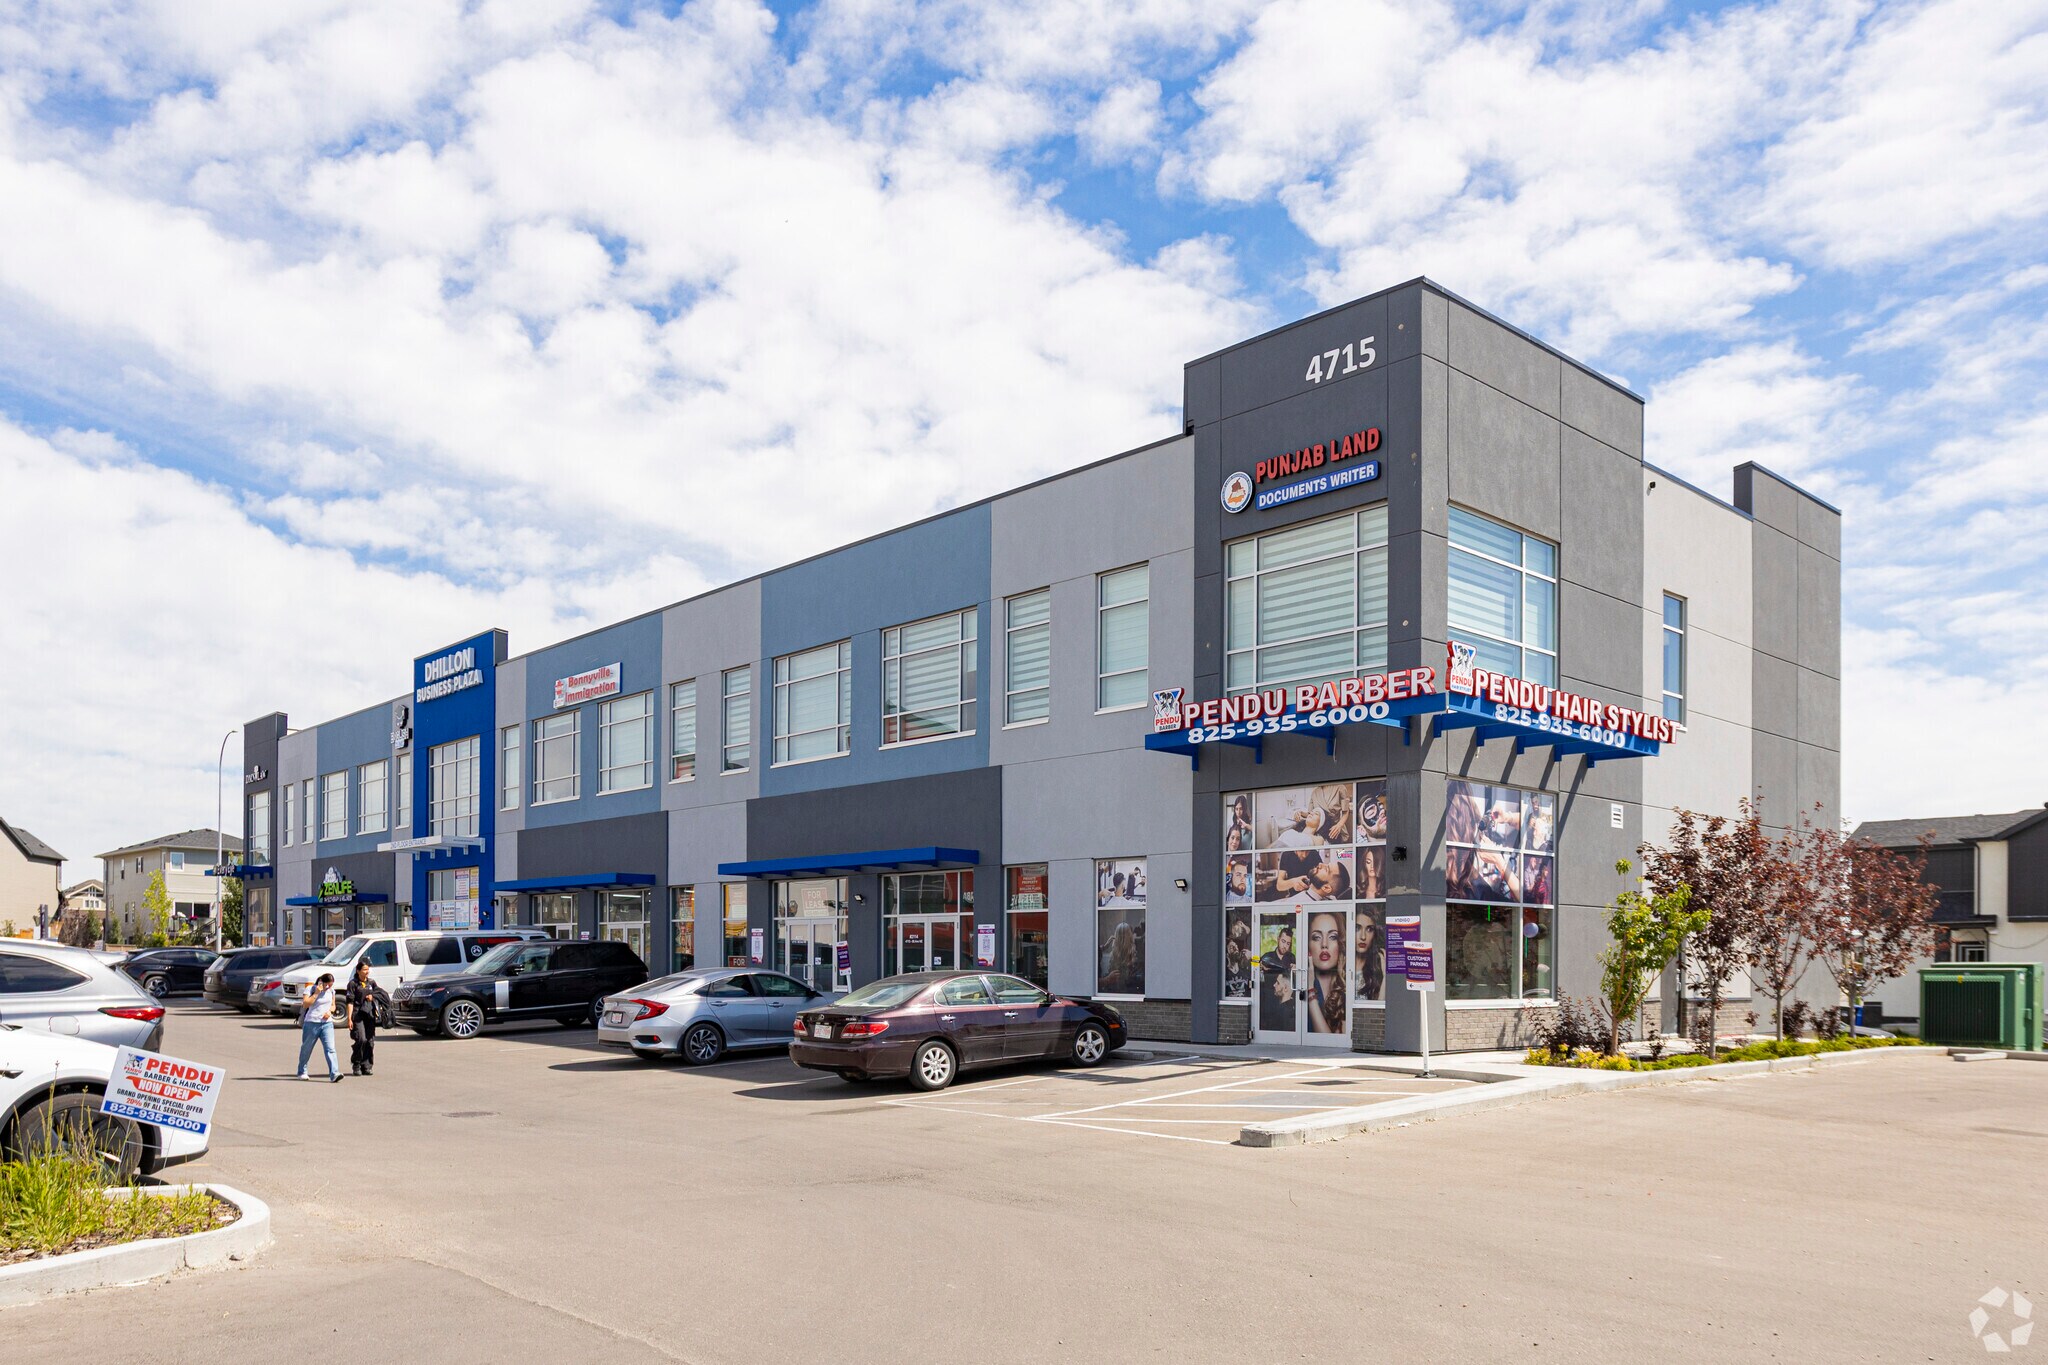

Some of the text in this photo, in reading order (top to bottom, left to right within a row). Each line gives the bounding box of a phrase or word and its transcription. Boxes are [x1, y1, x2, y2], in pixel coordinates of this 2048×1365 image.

[1305, 335, 1376, 384] 4715
[1255, 427, 1381, 484] PUNJAB LAND
[1258, 477, 1328, 508] DOCUMENTS
[1330, 464, 1375, 488] WRITER
[424, 647, 475, 683] DHILLON
[568, 667, 611, 688] Bonnyville
[416, 668, 484, 703] BUSINESS PLAZA
[564, 681, 616, 703] Immigration
[1452, 675, 1472, 687] PENDU
[1184, 666, 1436, 729] PENDU BARBER
[1473, 668, 1681, 744] PENDU HAIR STYLIST
[1155, 715, 1180, 726] PENDU
[1159, 723, 1177, 731] BARBER
[1188, 702, 1390, 744] 825-935-6000
[1495, 703, 1626, 748] 825-935-6000
[807, 890, 821, 900] FOR
[733, 958, 746, 966] FOR
[143, 1071, 211, 1093] BARBER & HAIRCUT
[146, 1058, 214, 1085] PENDU
[117, 1088, 204, 1114] GRAND OPENING SPECIAL OFFER
[138, 1080, 190, 1100] NOW OPEN
[109, 1102, 201, 1132] 825-935-6000
[126, 1097, 143, 1107] 20%
[151, 1103, 162, 1112] ALL
[162, 1106, 190, 1119] SERVICES
